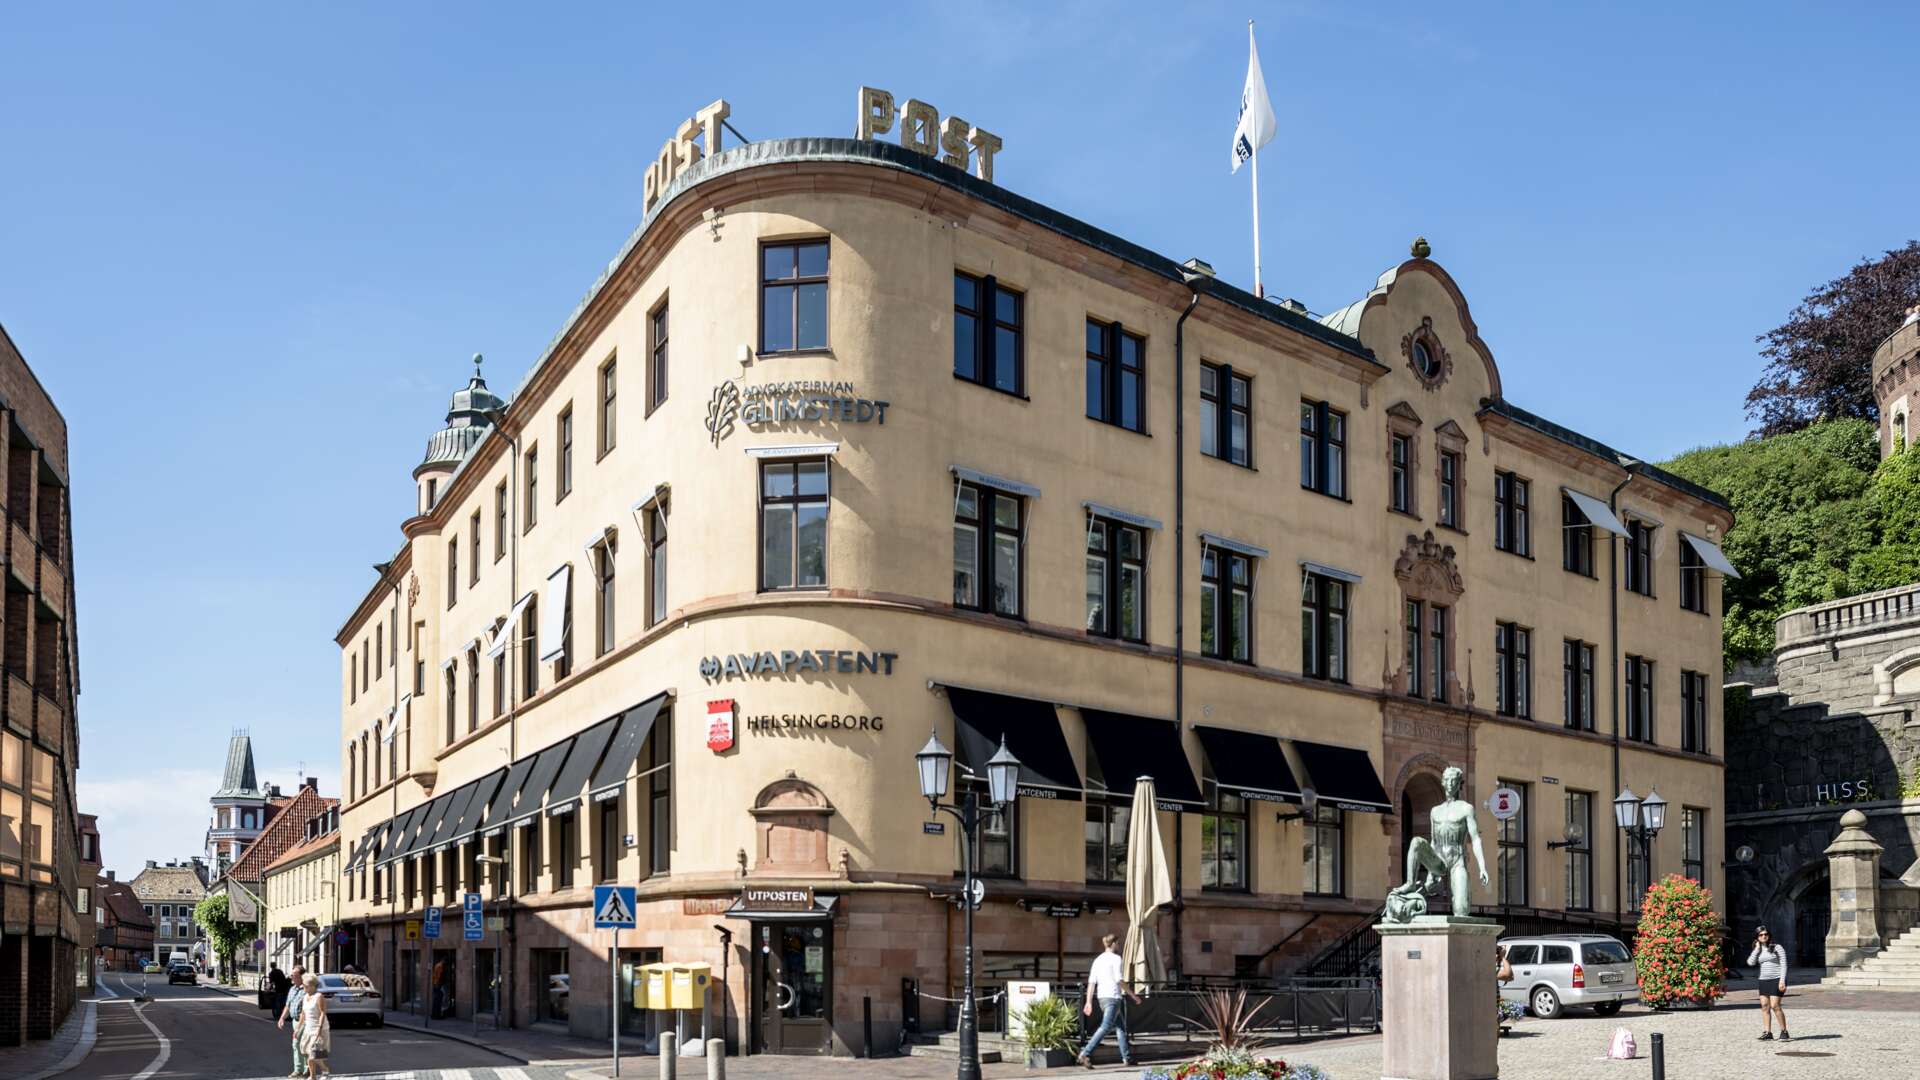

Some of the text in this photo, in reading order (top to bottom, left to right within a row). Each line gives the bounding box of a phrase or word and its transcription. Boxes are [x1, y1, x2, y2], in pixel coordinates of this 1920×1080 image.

[858, 85, 1003, 182] POST
[643, 98, 731, 217] POST
[743, 381, 853, 397] ADVOKATFIRMAN
[740, 399, 890, 425] GLIMSTEDT
[724, 650, 898, 676] AWAPATENT
[747, 714, 884, 731] HELSINGBORG
[1017, 790, 1057, 799] AKTCENTER
[1817, 779, 1868, 801] HISS
[468, 895, 480, 910] P
[748, 890, 808, 902] UTPOSTEN
[429, 908, 440, 921] P
